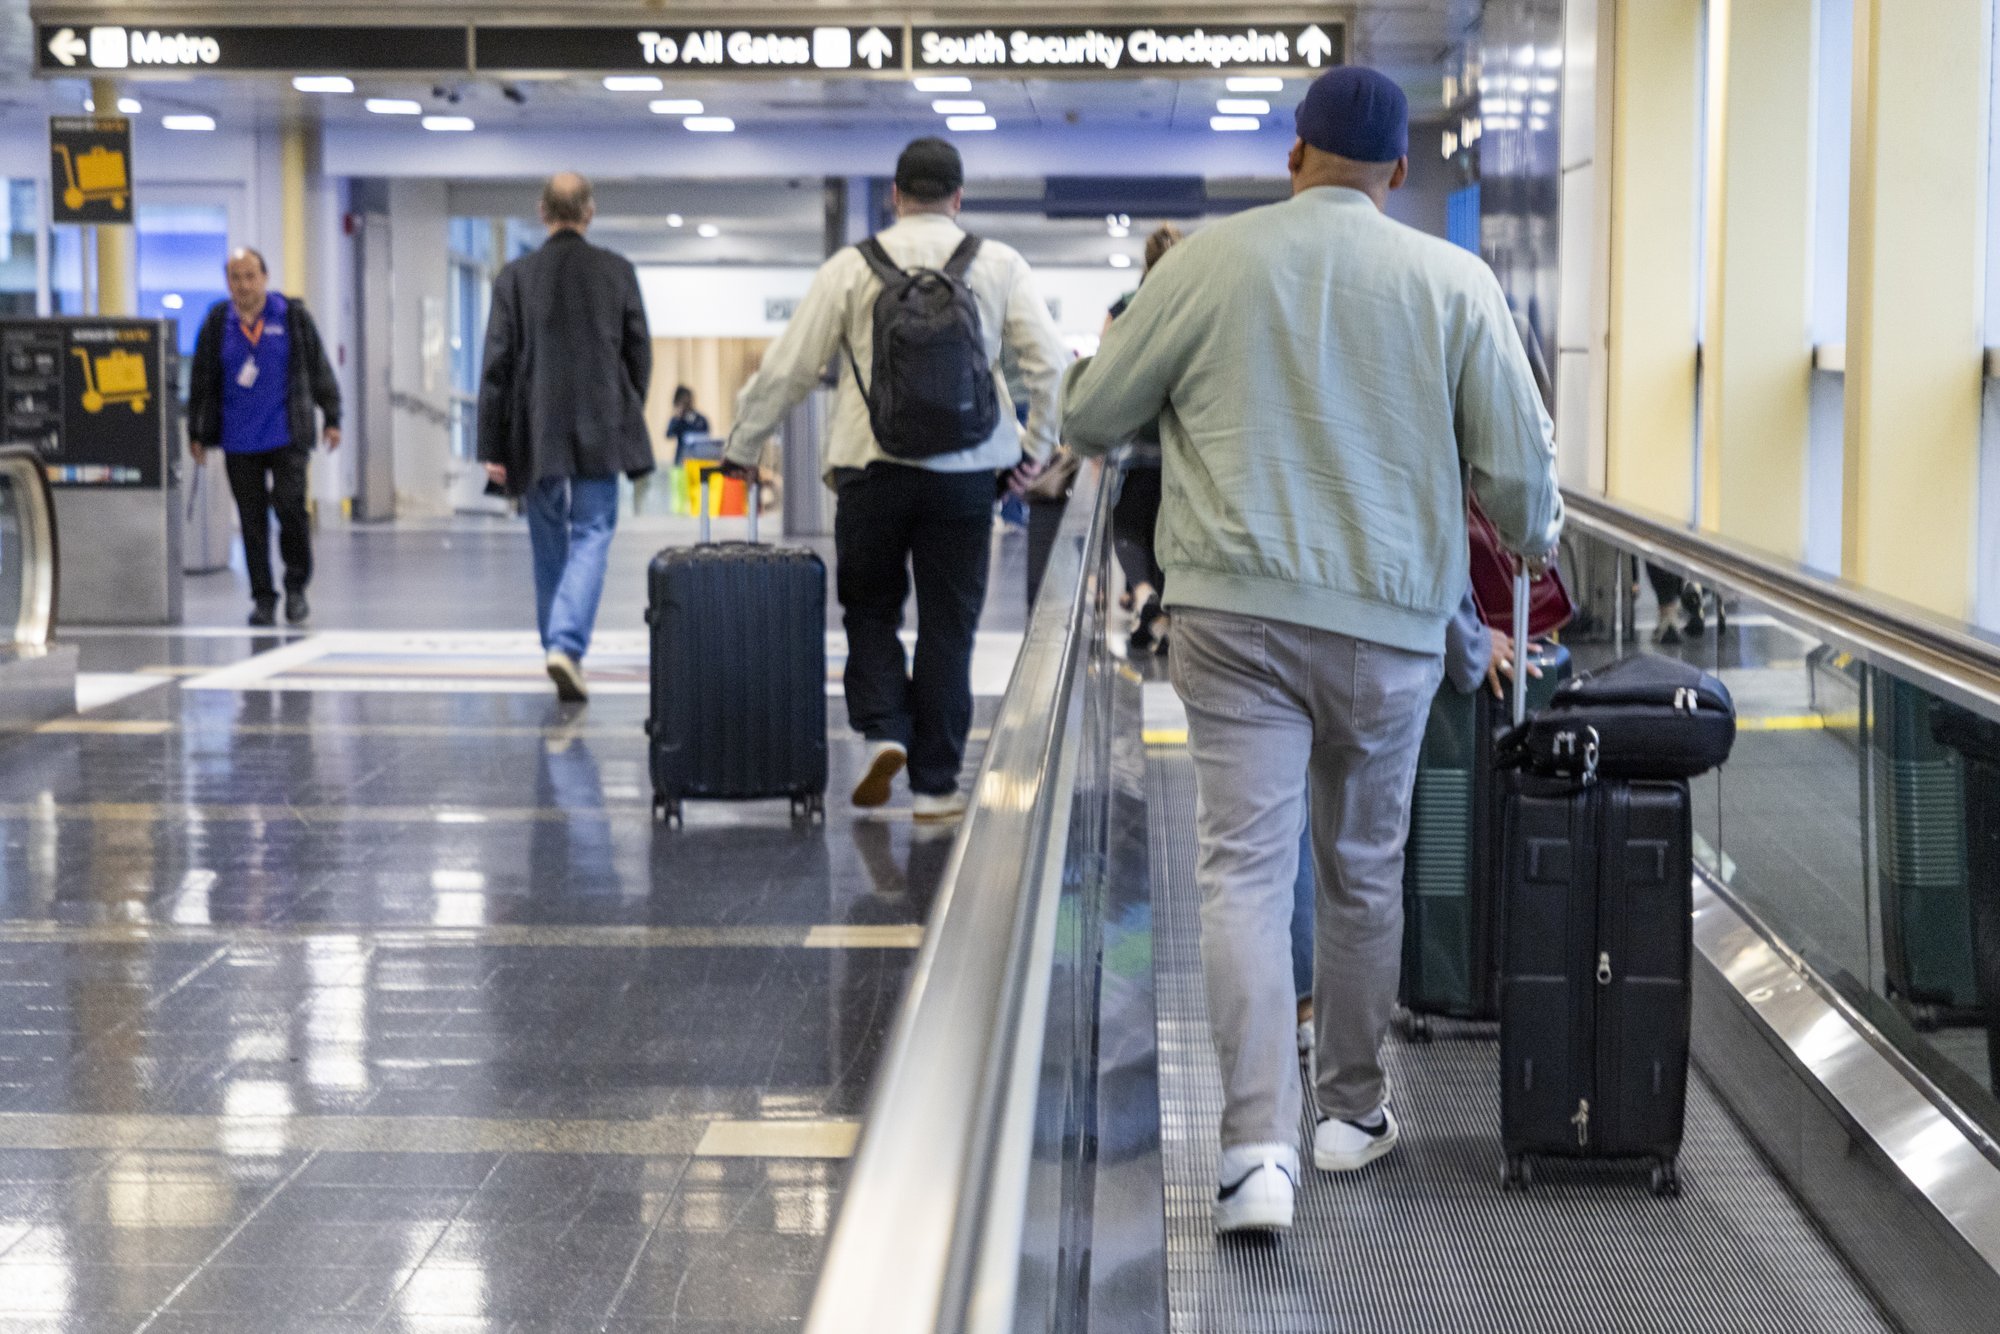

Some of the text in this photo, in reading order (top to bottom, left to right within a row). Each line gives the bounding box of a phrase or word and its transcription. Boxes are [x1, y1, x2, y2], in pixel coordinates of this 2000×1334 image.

[131, 31, 220, 64] Metro
[637, 31, 809, 64] To All Gates
[922, 28, 1290, 69] South Security Checkpoint
